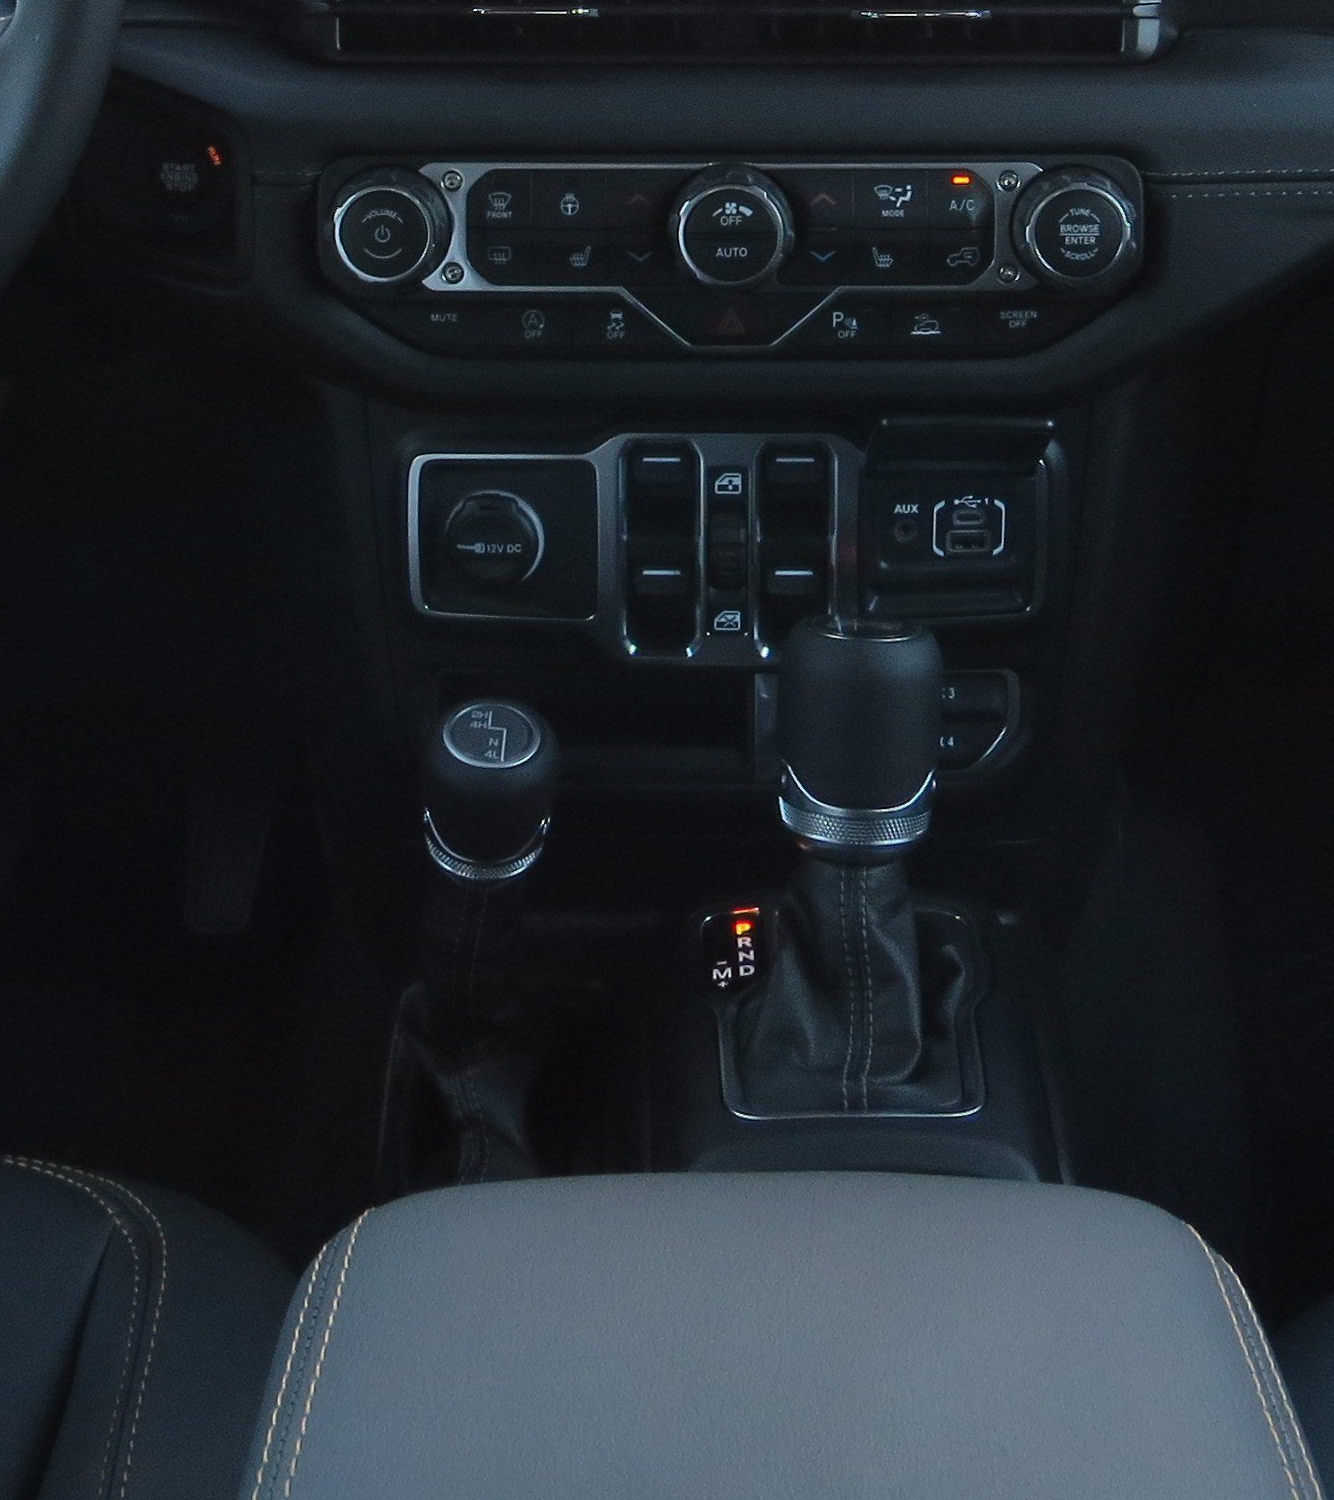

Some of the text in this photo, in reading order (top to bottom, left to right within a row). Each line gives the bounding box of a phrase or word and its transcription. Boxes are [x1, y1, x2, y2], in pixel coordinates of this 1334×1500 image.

[948, 199, 976, 212] A/C
[365, 208, 399, 219] VOLUME
[487, 211, 514, 220] FRONT
[881, 209, 905, 217] MODE
[1069, 208, 1090, 217] TUNE
[719, 215, 743, 226] OFF
[1059, 223, 1100, 233] BROWSE
[1065, 236, 1096, 245] ENTER
[714, 246, 749, 259] AUTO
[1064, 250, 1097, 261] SCROLL
[430, 313, 459, 322] MUTE
[999, 310, 1038, 321] SCREEN
[1008, 320, 1027, 329] OFF
[523, 329, 545, 339] OFF
[608, 329, 626, 340] OFF
[838, 329, 857, 339] OFF
[893, 503, 919, 514] AUX
[487, 544, 522, 553] 12V DC
[469, 720, 487, 729] 4H
[488, 737, 499, 747] N
[484, 750, 499, 759] 4L
[735, 921, 752, 936] P
[737, 936, 753, 948] R
[738, 949, 755, 962] N
[712, 966, 732, 980] M
[739, 964, 755, 977] D
